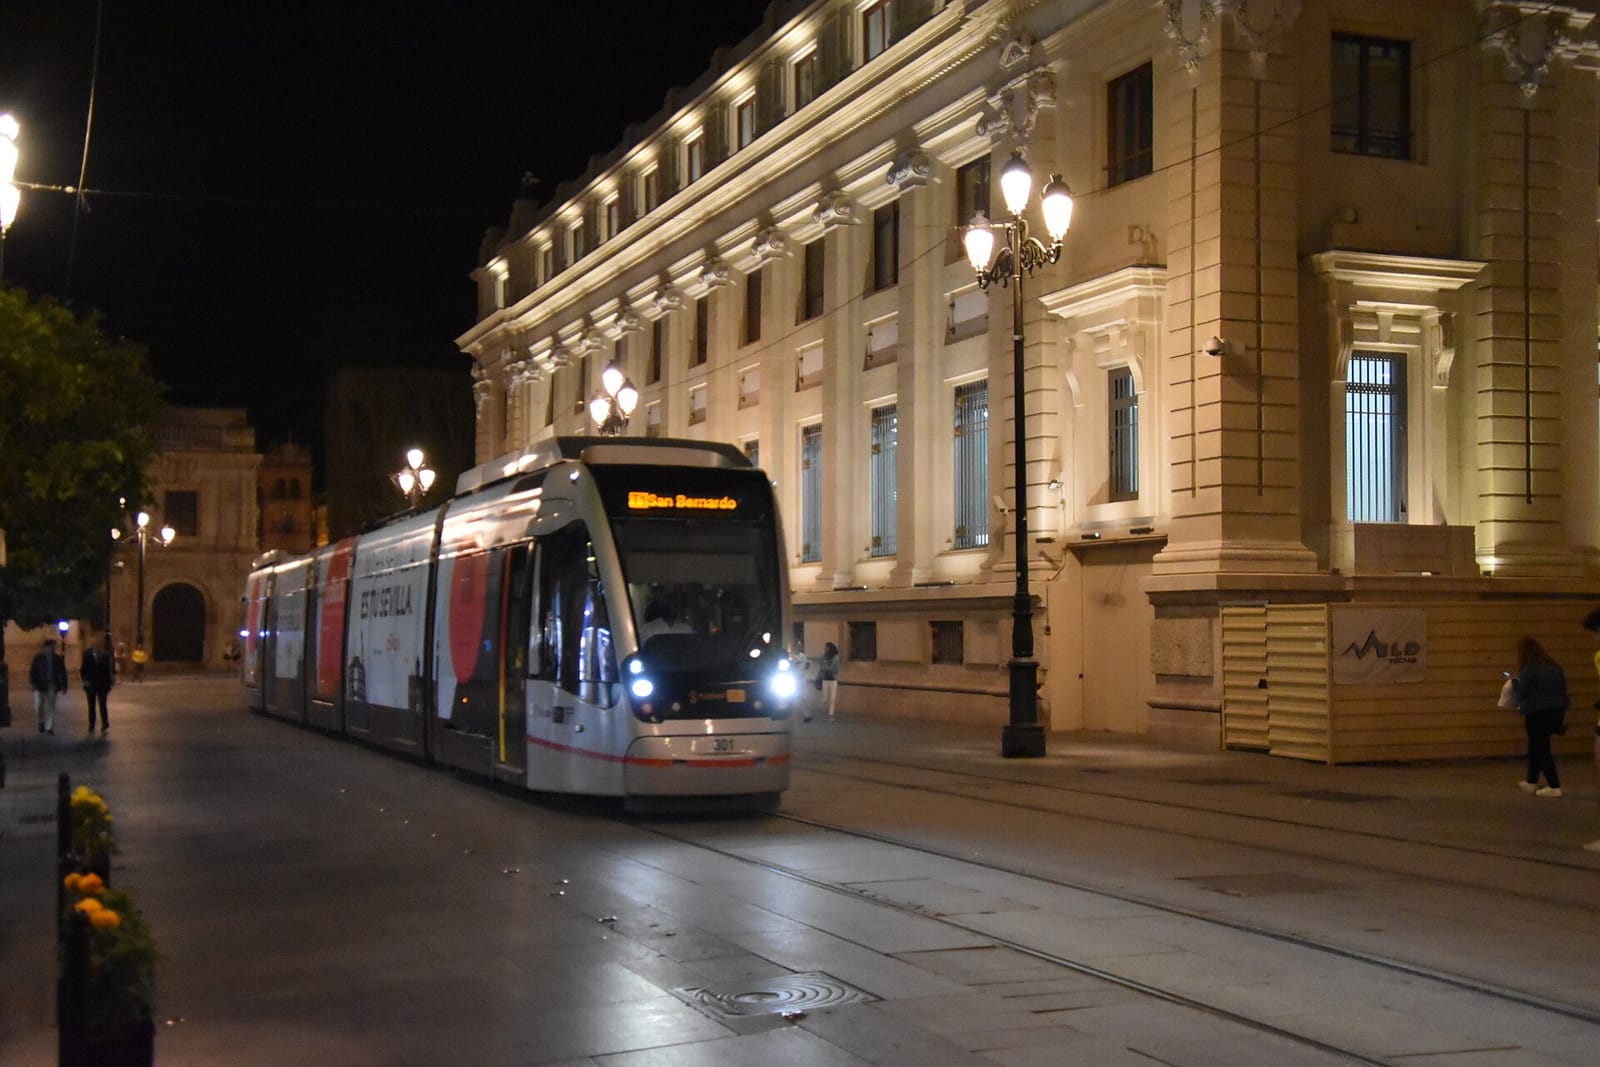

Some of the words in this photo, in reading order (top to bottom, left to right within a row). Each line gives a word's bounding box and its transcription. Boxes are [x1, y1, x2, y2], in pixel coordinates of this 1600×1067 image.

[648, 493, 674, 508] San
[676, 494, 737, 509] Bernardo
[379, 583, 413, 618] SEVILLA
[713, 738, 735, 752] 301
